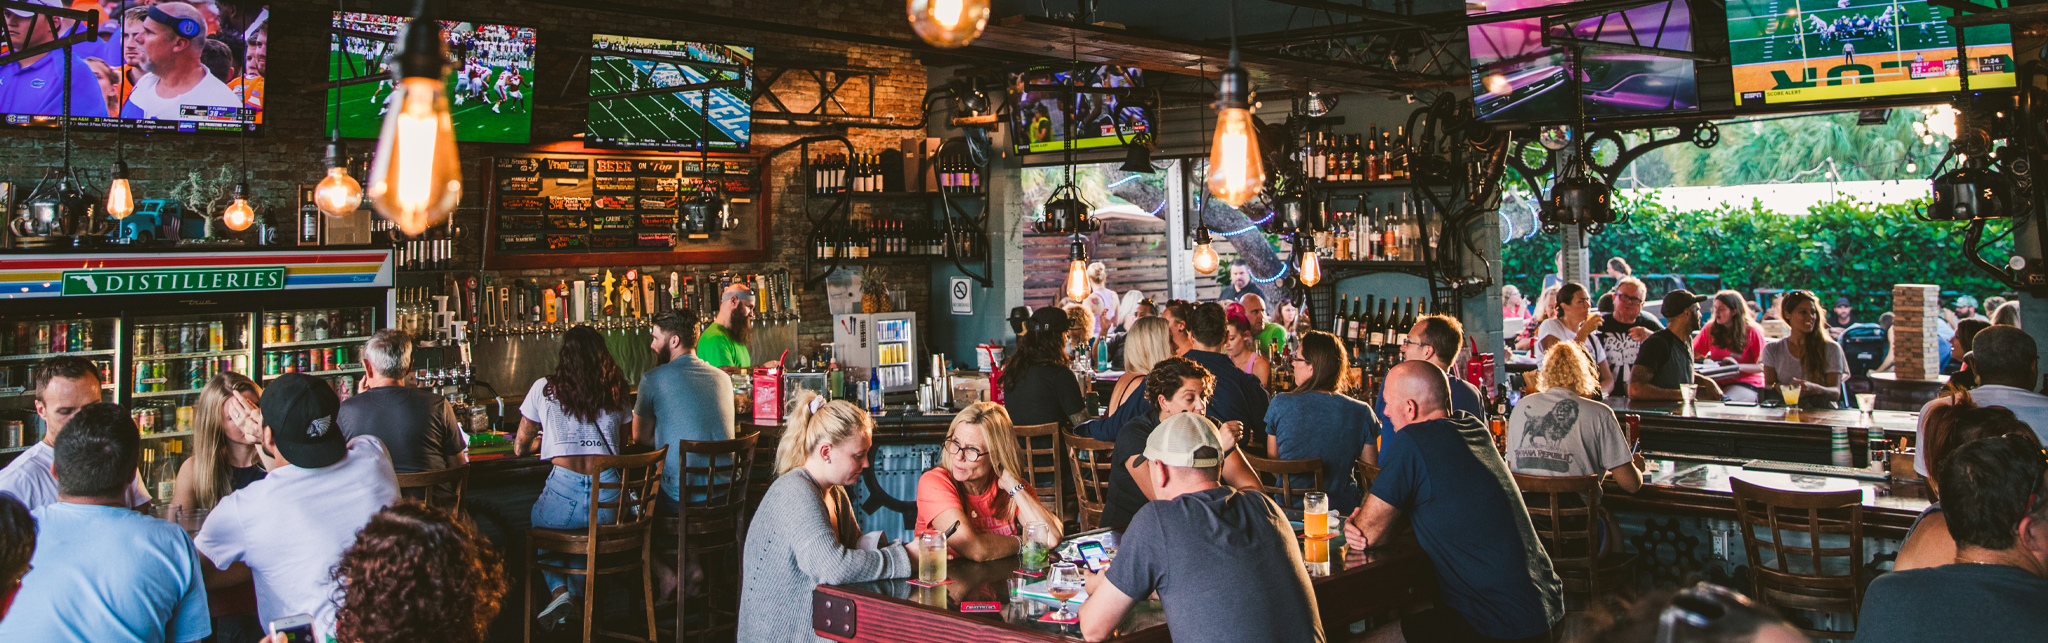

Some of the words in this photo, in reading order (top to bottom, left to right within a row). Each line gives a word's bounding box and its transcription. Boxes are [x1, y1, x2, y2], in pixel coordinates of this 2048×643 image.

[1911, 66, 1922, 74] 13
[1945, 64, 1957, 72] 20
[596, 159, 632, 172] BEER
[638, 162, 647, 170] ON
[105, 271, 278, 292] DISTILLERIES
[1537, 449, 1574, 464] REPUBLIC
